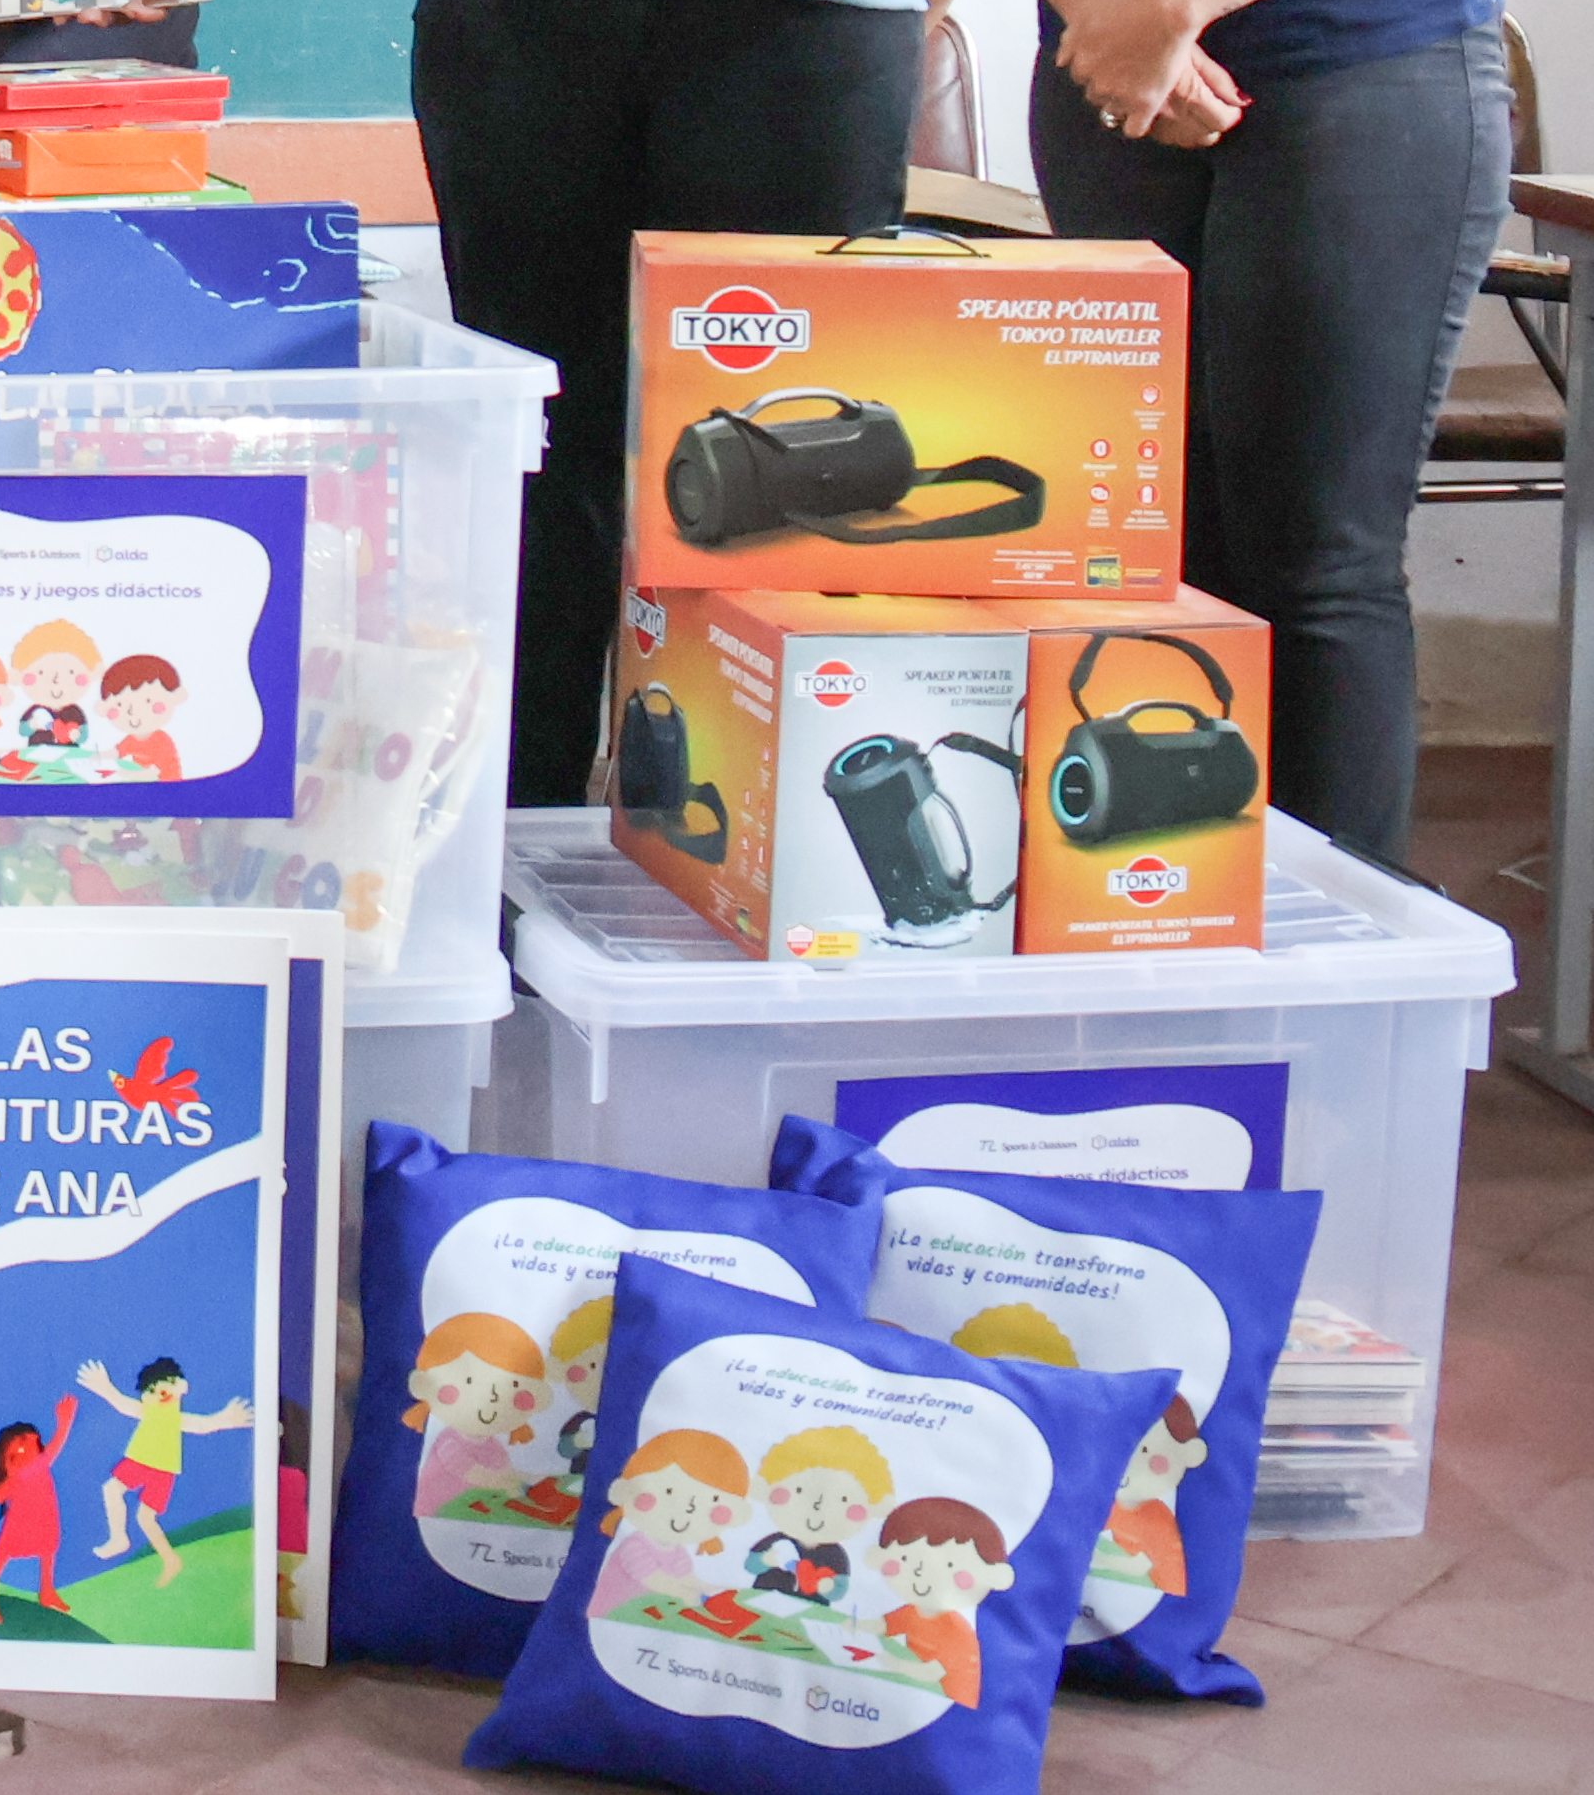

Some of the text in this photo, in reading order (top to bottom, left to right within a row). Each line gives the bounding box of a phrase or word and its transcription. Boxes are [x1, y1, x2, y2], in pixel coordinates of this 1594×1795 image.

[958, 299, 1050, 320] SPEAKER
[683, 316, 798, 342] TOKYO
[1000, 326, 1160, 345] TOKYO TRAVELER
[1045, 350, 1160, 366] ELTPTRAVELER
[114, 548, 148, 561] alda
[21, 587, 30, 600] y
[35, 583, 99, 600] juegos
[105, 583, 202, 598] didácticos
[801, 676, 866, 694] TOKYO
[904, 670, 955, 682] SPEAKER
[1115, 873, 1181, 890] TOKYO
[1109, 1137, 1139, 1148] alda
[1099, 1165, 1189, 1183] didácticos
[14, 1170, 142, 1217] ANA
[495, 1234, 524, 1250] ¡La
[533, 1238, 620, 1261] educación
[890, 1230, 1145, 1280] ¡La educación transforma
[513, 1258, 557, 1274] vidas
[566, 1266, 577, 1282] y
[907, 1256, 1119, 1299] vidas y comunidades!
[725, 1359, 974, 1416] ¡La educación transforma
[739, 1381, 947, 1431] vidas y comunidades!
[669, 1660, 709, 1686] Sports
[711, 1670, 722, 1686] &
[724, 1673, 782, 1702] Outdoors
[831, 1697, 880, 1724] alda
